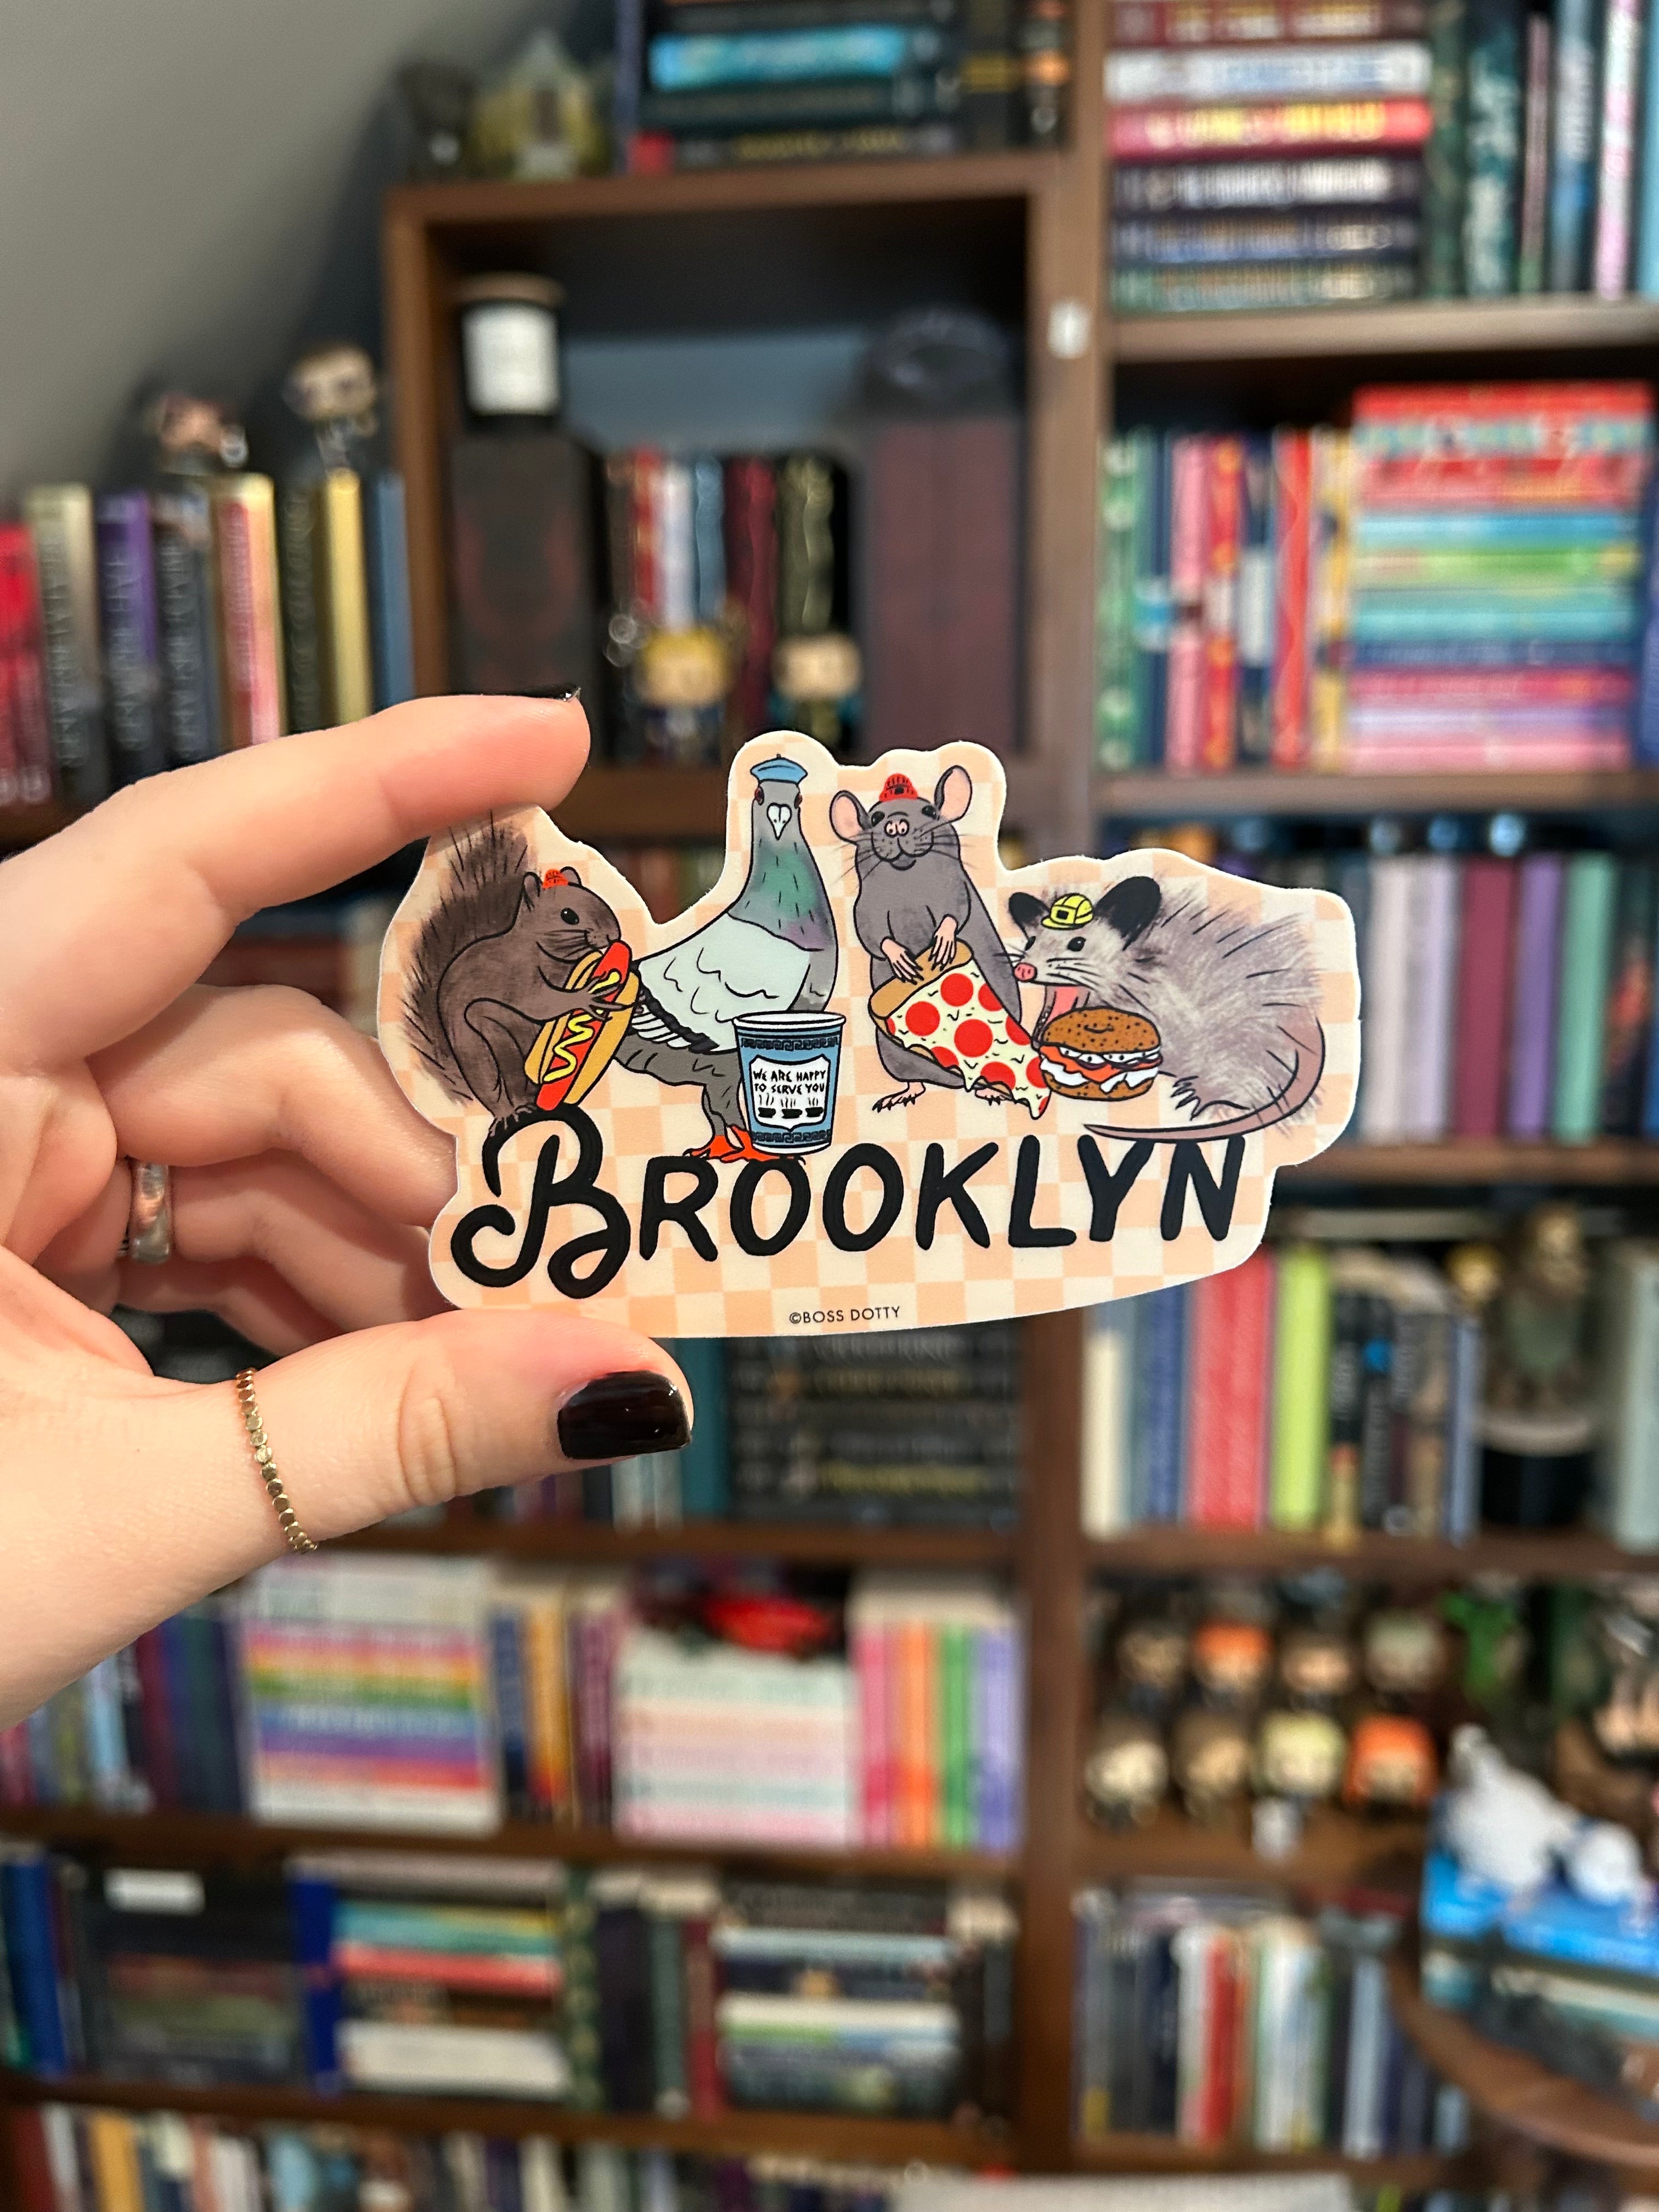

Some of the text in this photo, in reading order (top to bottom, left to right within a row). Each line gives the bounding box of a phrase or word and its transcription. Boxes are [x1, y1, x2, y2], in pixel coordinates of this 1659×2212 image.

[753, 1068, 826, 1082] WE ARE HAPPY
[754, 1083, 825, 1095] TO SERVE YOU
[450, 1107, 1246, 1299] BROOKLYN
[850, 1306, 900, 1321] DOTTY
